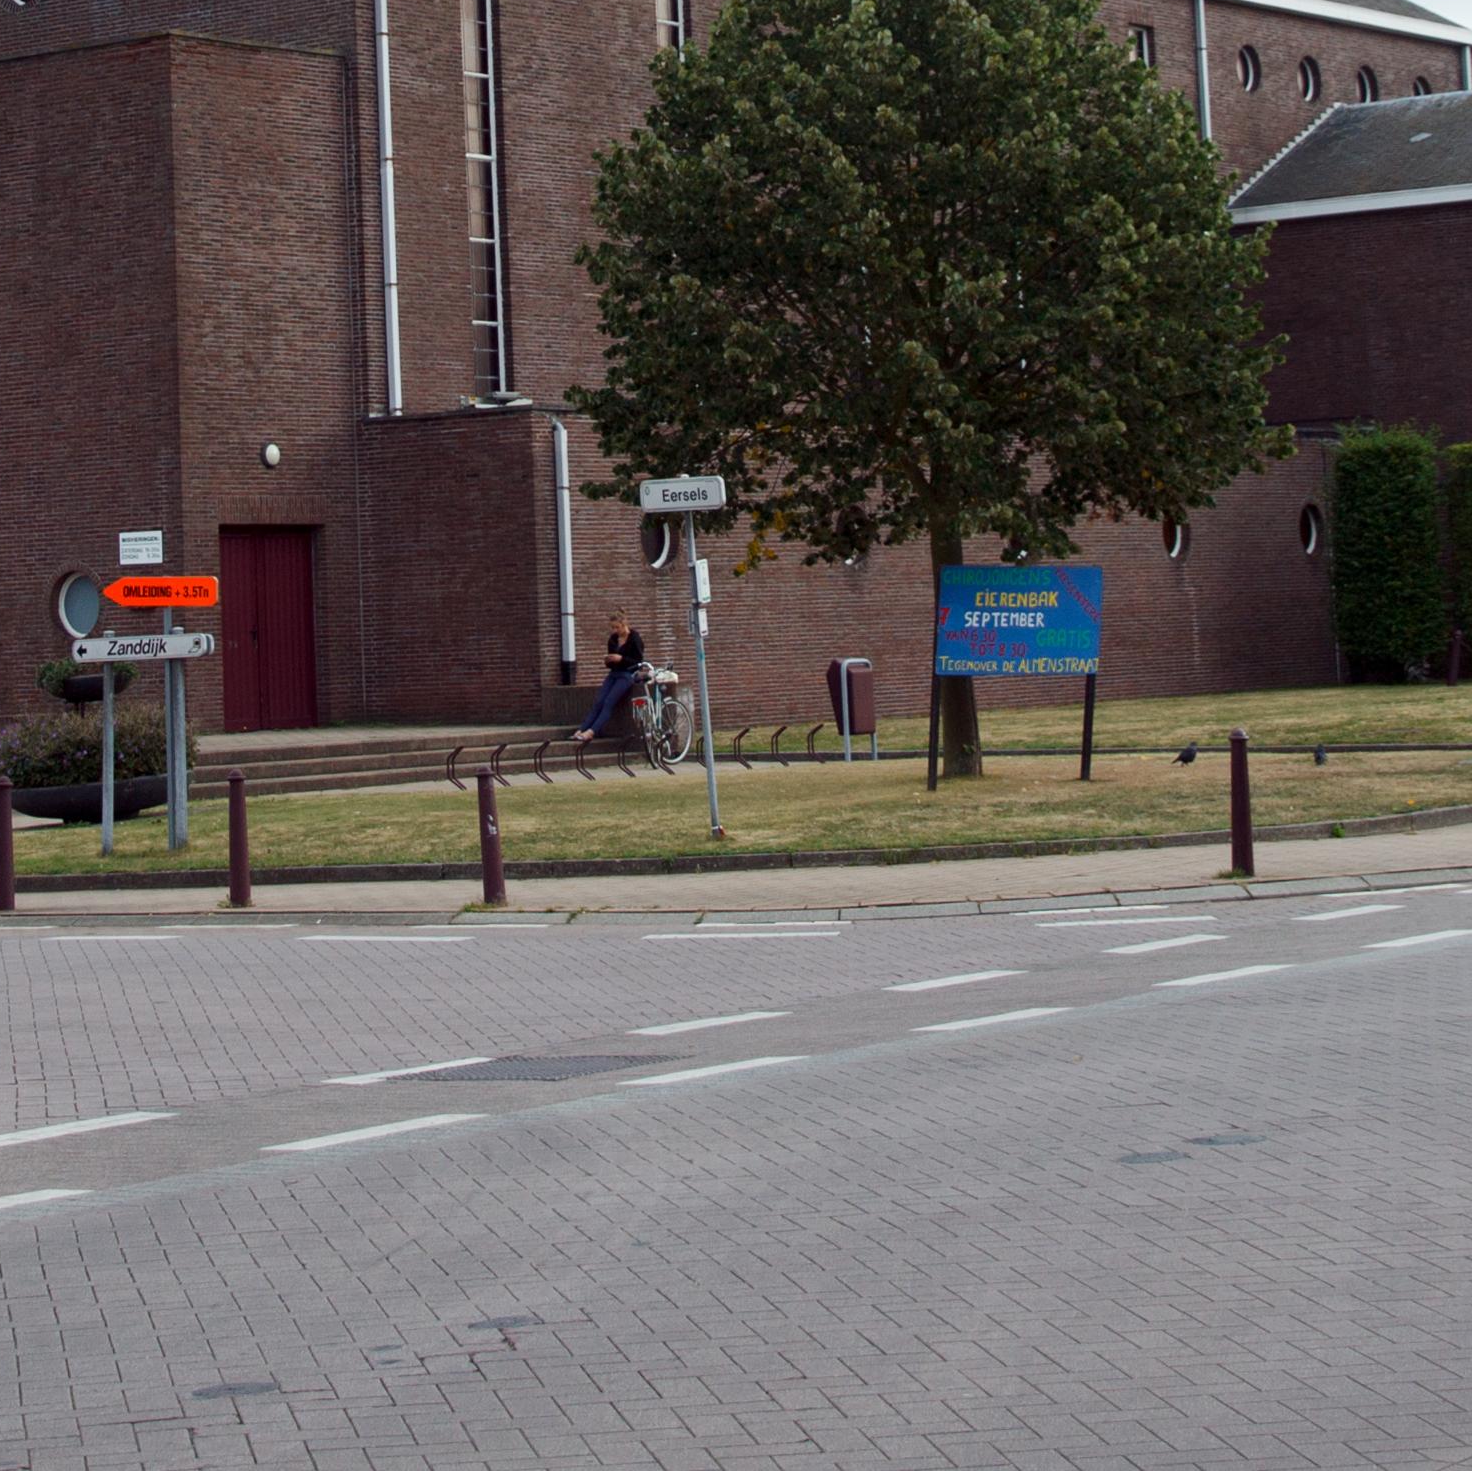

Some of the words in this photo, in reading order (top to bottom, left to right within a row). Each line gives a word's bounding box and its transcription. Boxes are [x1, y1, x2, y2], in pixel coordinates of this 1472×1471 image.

[662, 487, 708, 503] Eersels
[123, 585, 172, 598] OMLEIDING
[964, 611, 1045, 628] SEPTEMBER
[1036, 629, 1092, 649] GRATIS
[107, 639, 166, 657] Zanddijk
